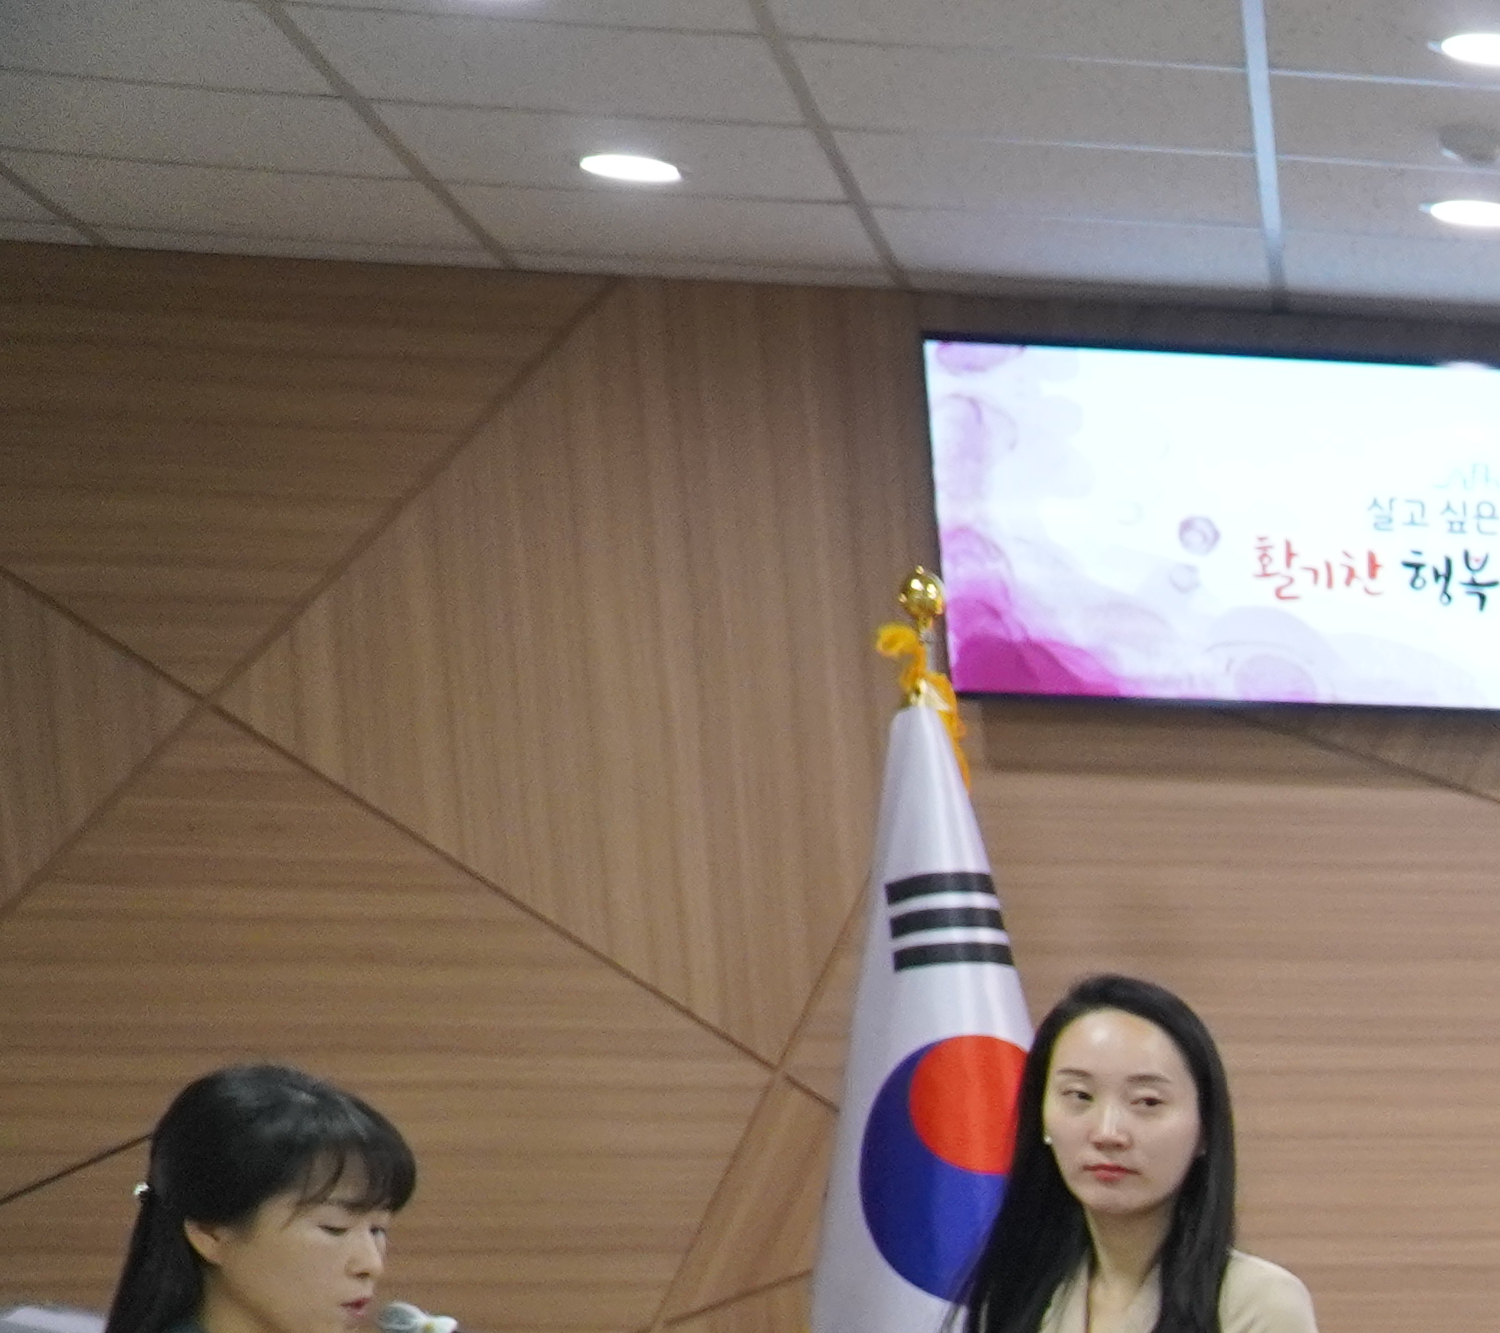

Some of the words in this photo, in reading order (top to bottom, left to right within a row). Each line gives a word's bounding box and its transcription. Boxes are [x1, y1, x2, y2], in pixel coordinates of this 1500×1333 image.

[1366, 496, 1431, 533] 살고
[1439, 499, 1500, 536] 싶은
[1251, 535, 1385, 601] 활기찬
